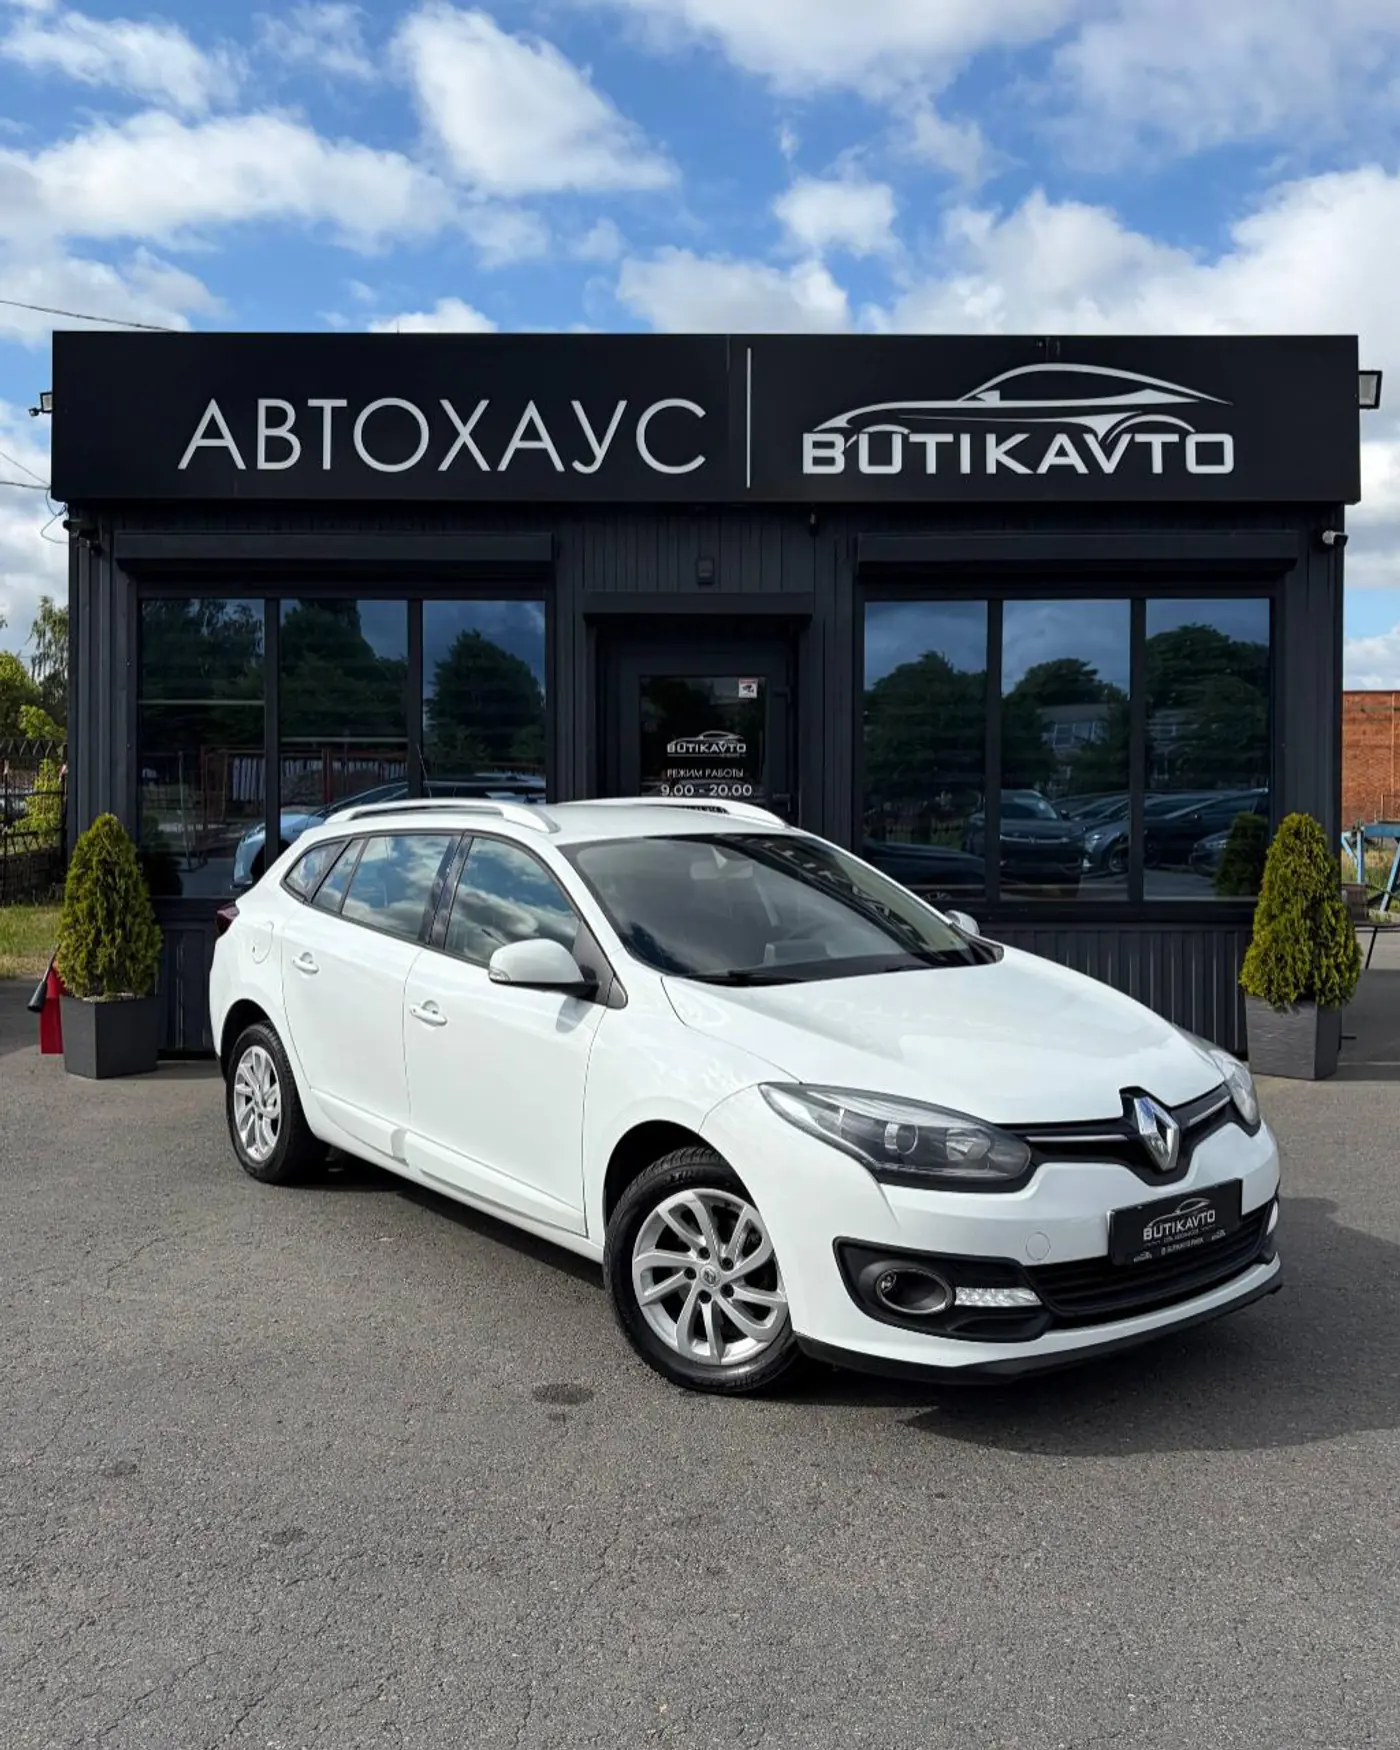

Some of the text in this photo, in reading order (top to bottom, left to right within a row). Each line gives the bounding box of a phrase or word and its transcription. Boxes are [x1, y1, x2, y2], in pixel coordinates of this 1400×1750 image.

[178, 398, 706, 474] АВТОХАУС
[802, 432, 1235, 475] BUTIKAVTO
[667, 743, 747, 753] BUTIKAVTO
[667, 768, 744, 778] РЕЖИМ РАБОТЫ
[661, 784, 694, 797] 9.00
[709, 784, 752, 797] 20.00
[1143, 1209, 1216, 1241] BUTIKAVTO
